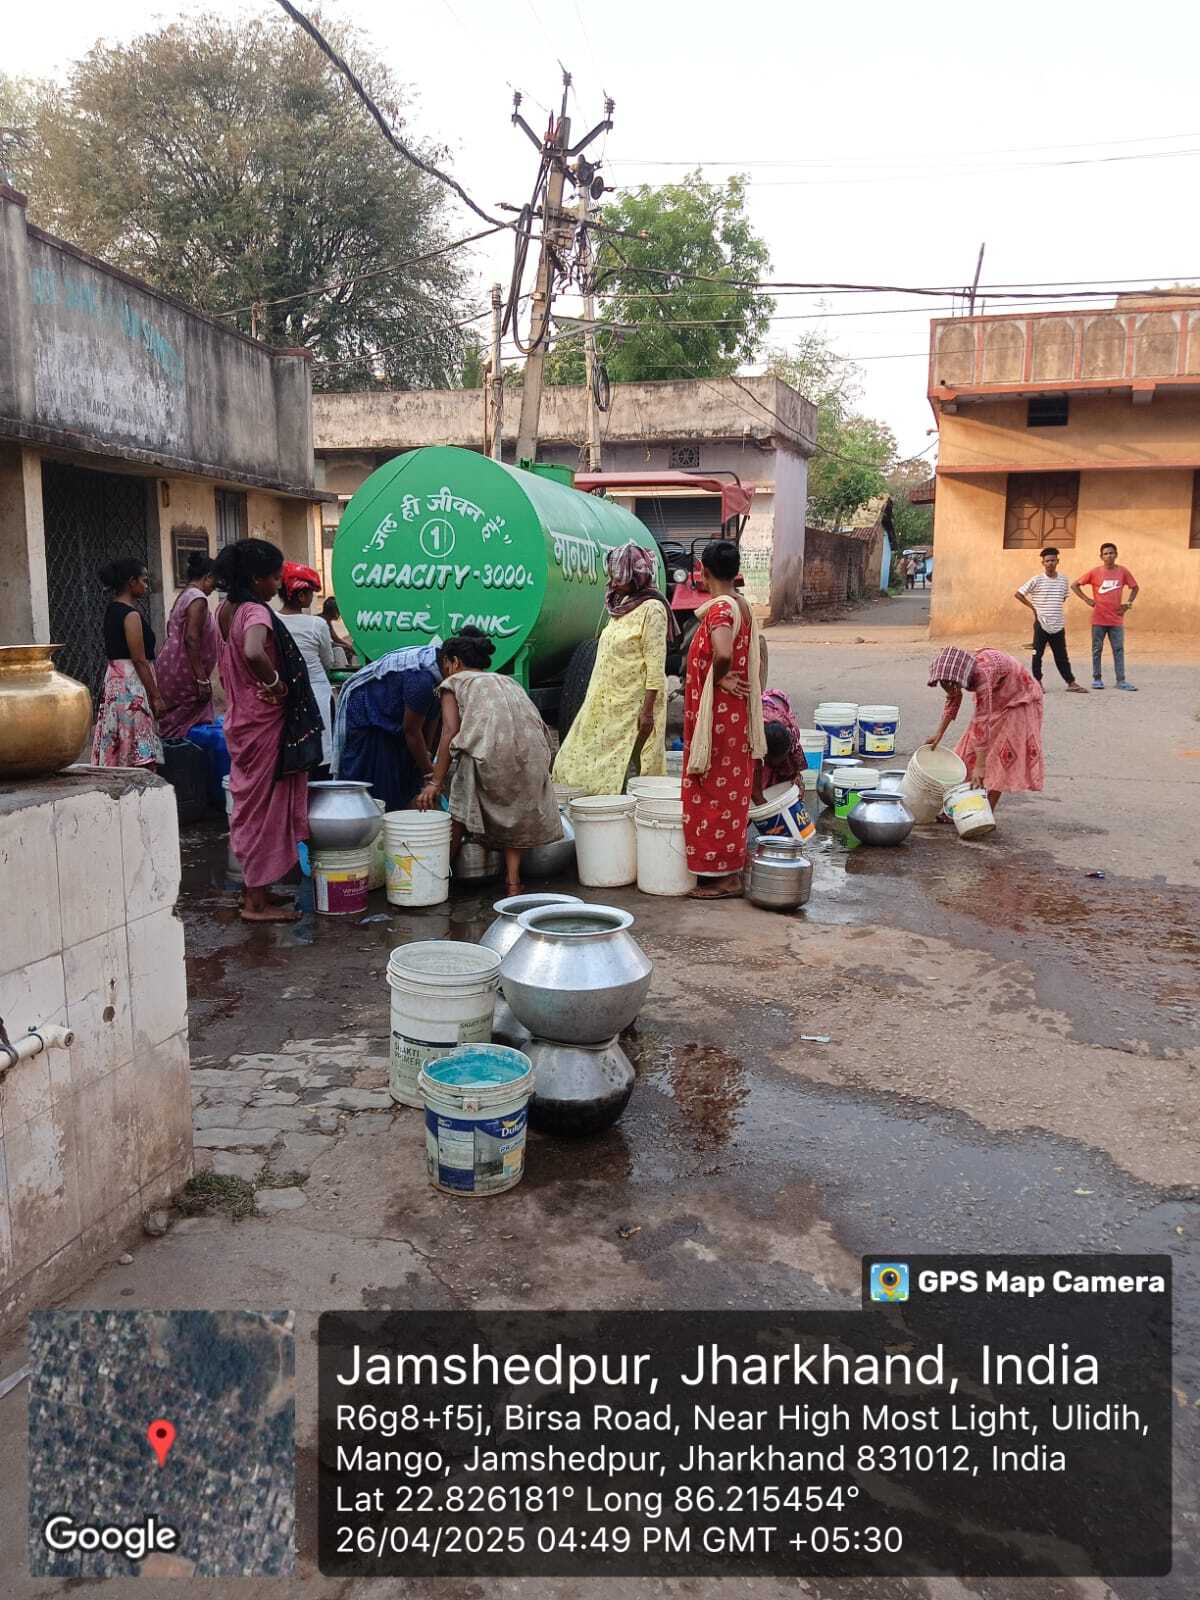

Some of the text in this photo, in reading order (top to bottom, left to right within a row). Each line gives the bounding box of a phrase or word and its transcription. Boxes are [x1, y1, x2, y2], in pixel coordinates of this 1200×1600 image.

[400, 494, 421, 522] ही
[426, 486, 485, 522] जीवन
[430, 526, 440, 550] 1
[356, 609, 524, 638] WATER TANK
